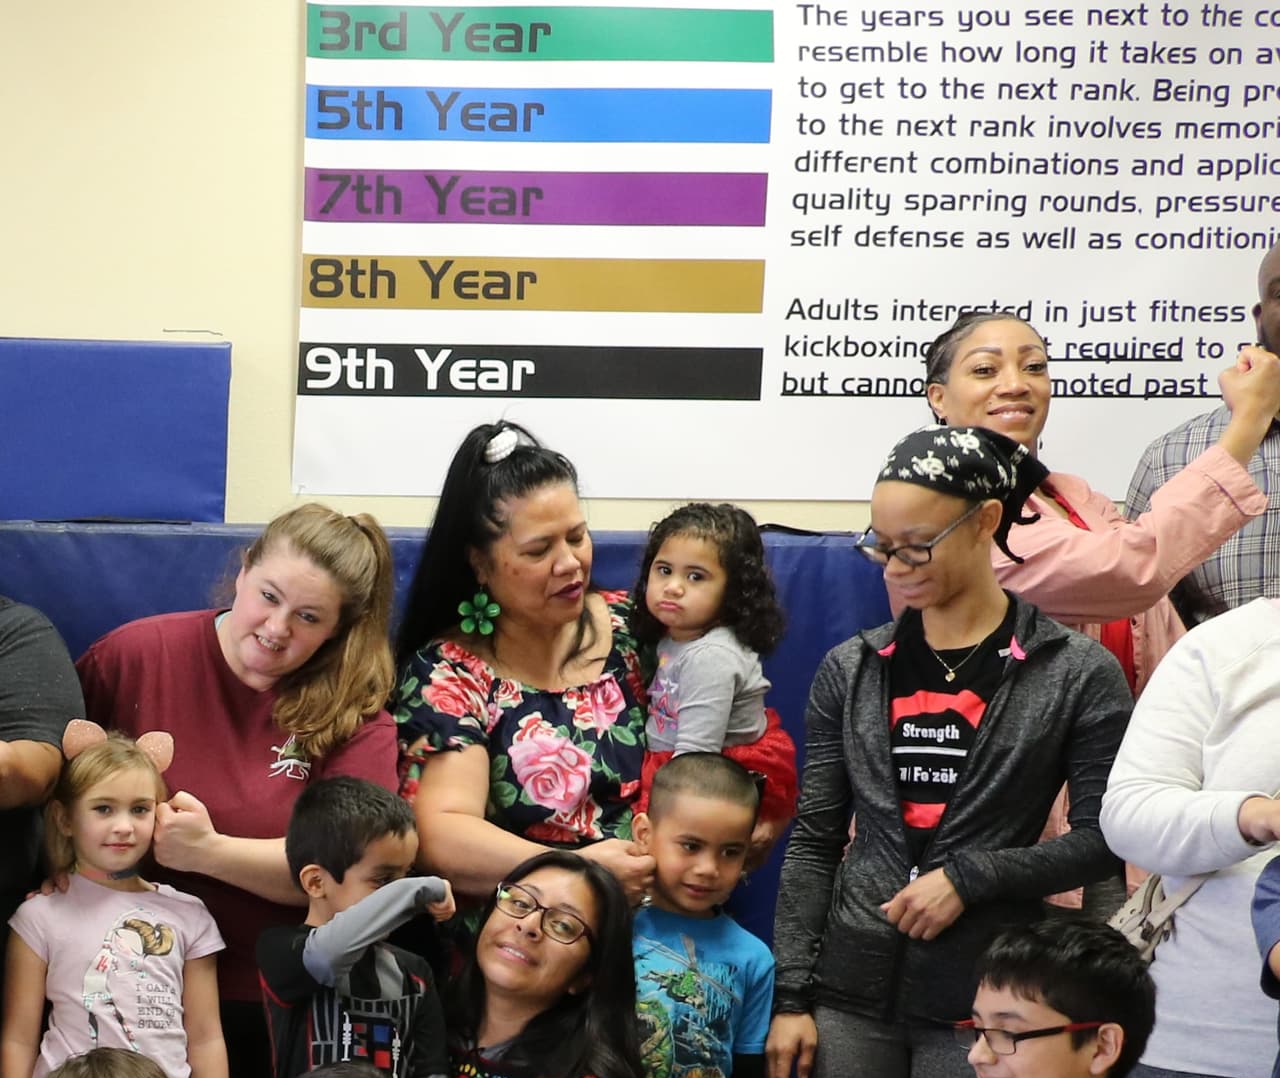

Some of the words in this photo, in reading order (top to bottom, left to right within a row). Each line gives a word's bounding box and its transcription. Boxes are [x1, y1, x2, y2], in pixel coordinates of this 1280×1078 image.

[317, 9, 407, 52] 3rd
[429, 11, 552, 54] Year
[796, 3, 848, 26] The
[861, 10, 944, 32] years
[958, 10, 1010, 33] you
[1024, 9, 1073, 26] see
[1087, 3, 1149, 26] next
[1160, 2, 1189, 27] to
[1200, 3, 1243, 27] the
[798, 40, 928, 63] resemble
[941, 41, 1003, 63] how
[1016, 40, 1076, 69] long
[1089, 40, 1109, 64] it
[1120, 40, 1197, 65] takes
[1208, 47, 1242, 65] on
[797, 76, 827, 99] to
[840, 76, 885, 105] get
[897, 77, 927, 100] to
[939, 77, 985, 100] the
[998, 77, 1058, 101] next
[1070, 78, 1140, 102] rank.
[1152, 78, 1230, 108] Being
[1243, 84, 1280, 108] pr
[317, 89, 403, 131] 5th
[426, 91, 545, 133] Year
[796, 113, 826, 136] to
[838, 113, 884, 136] the
[896, 114, 957, 137] next
[969, 114, 1036, 138] rank
[1048, 115, 1162, 139] involves
[794, 150, 918, 174] different
[930, 151, 1119, 176] combinations
[1131, 153, 1184, 176] and
[1196, 152, 1280, 182] applic
[317, 173, 403, 216] 7th
[423, 174, 544, 217] Year
[792, 187, 891, 216] quality
[904, 188, 1027, 218] sparring
[1155, 195, 1280, 219] pressure
[790, 224, 843, 247] self
[854, 224, 965, 248] defense
[976, 231, 1010, 249] as
[1022, 226, 1076, 249] well
[1087, 232, 1122, 250] as
[1134, 226, 1280, 250] conditioni
[309, 258, 396, 299] 8th
[418, 259, 538, 301] Year
[785, 298, 879, 321] Adults
[1045, 300, 1068, 323] in
[1078, 300, 1137, 329] just
[1149, 299, 1246, 323] fitness
[1065, 337, 1183, 363] required
[1195, 336, 1224, 359] to
[305, 347, 394, 390] 9th
[414, 348, 536, 391] Year
[782, 373, 828, 395] but
[842, 377, 926, 395] canno
[1144, 374, 1208, 400] past
[902, 722, 960, 743] Strength
